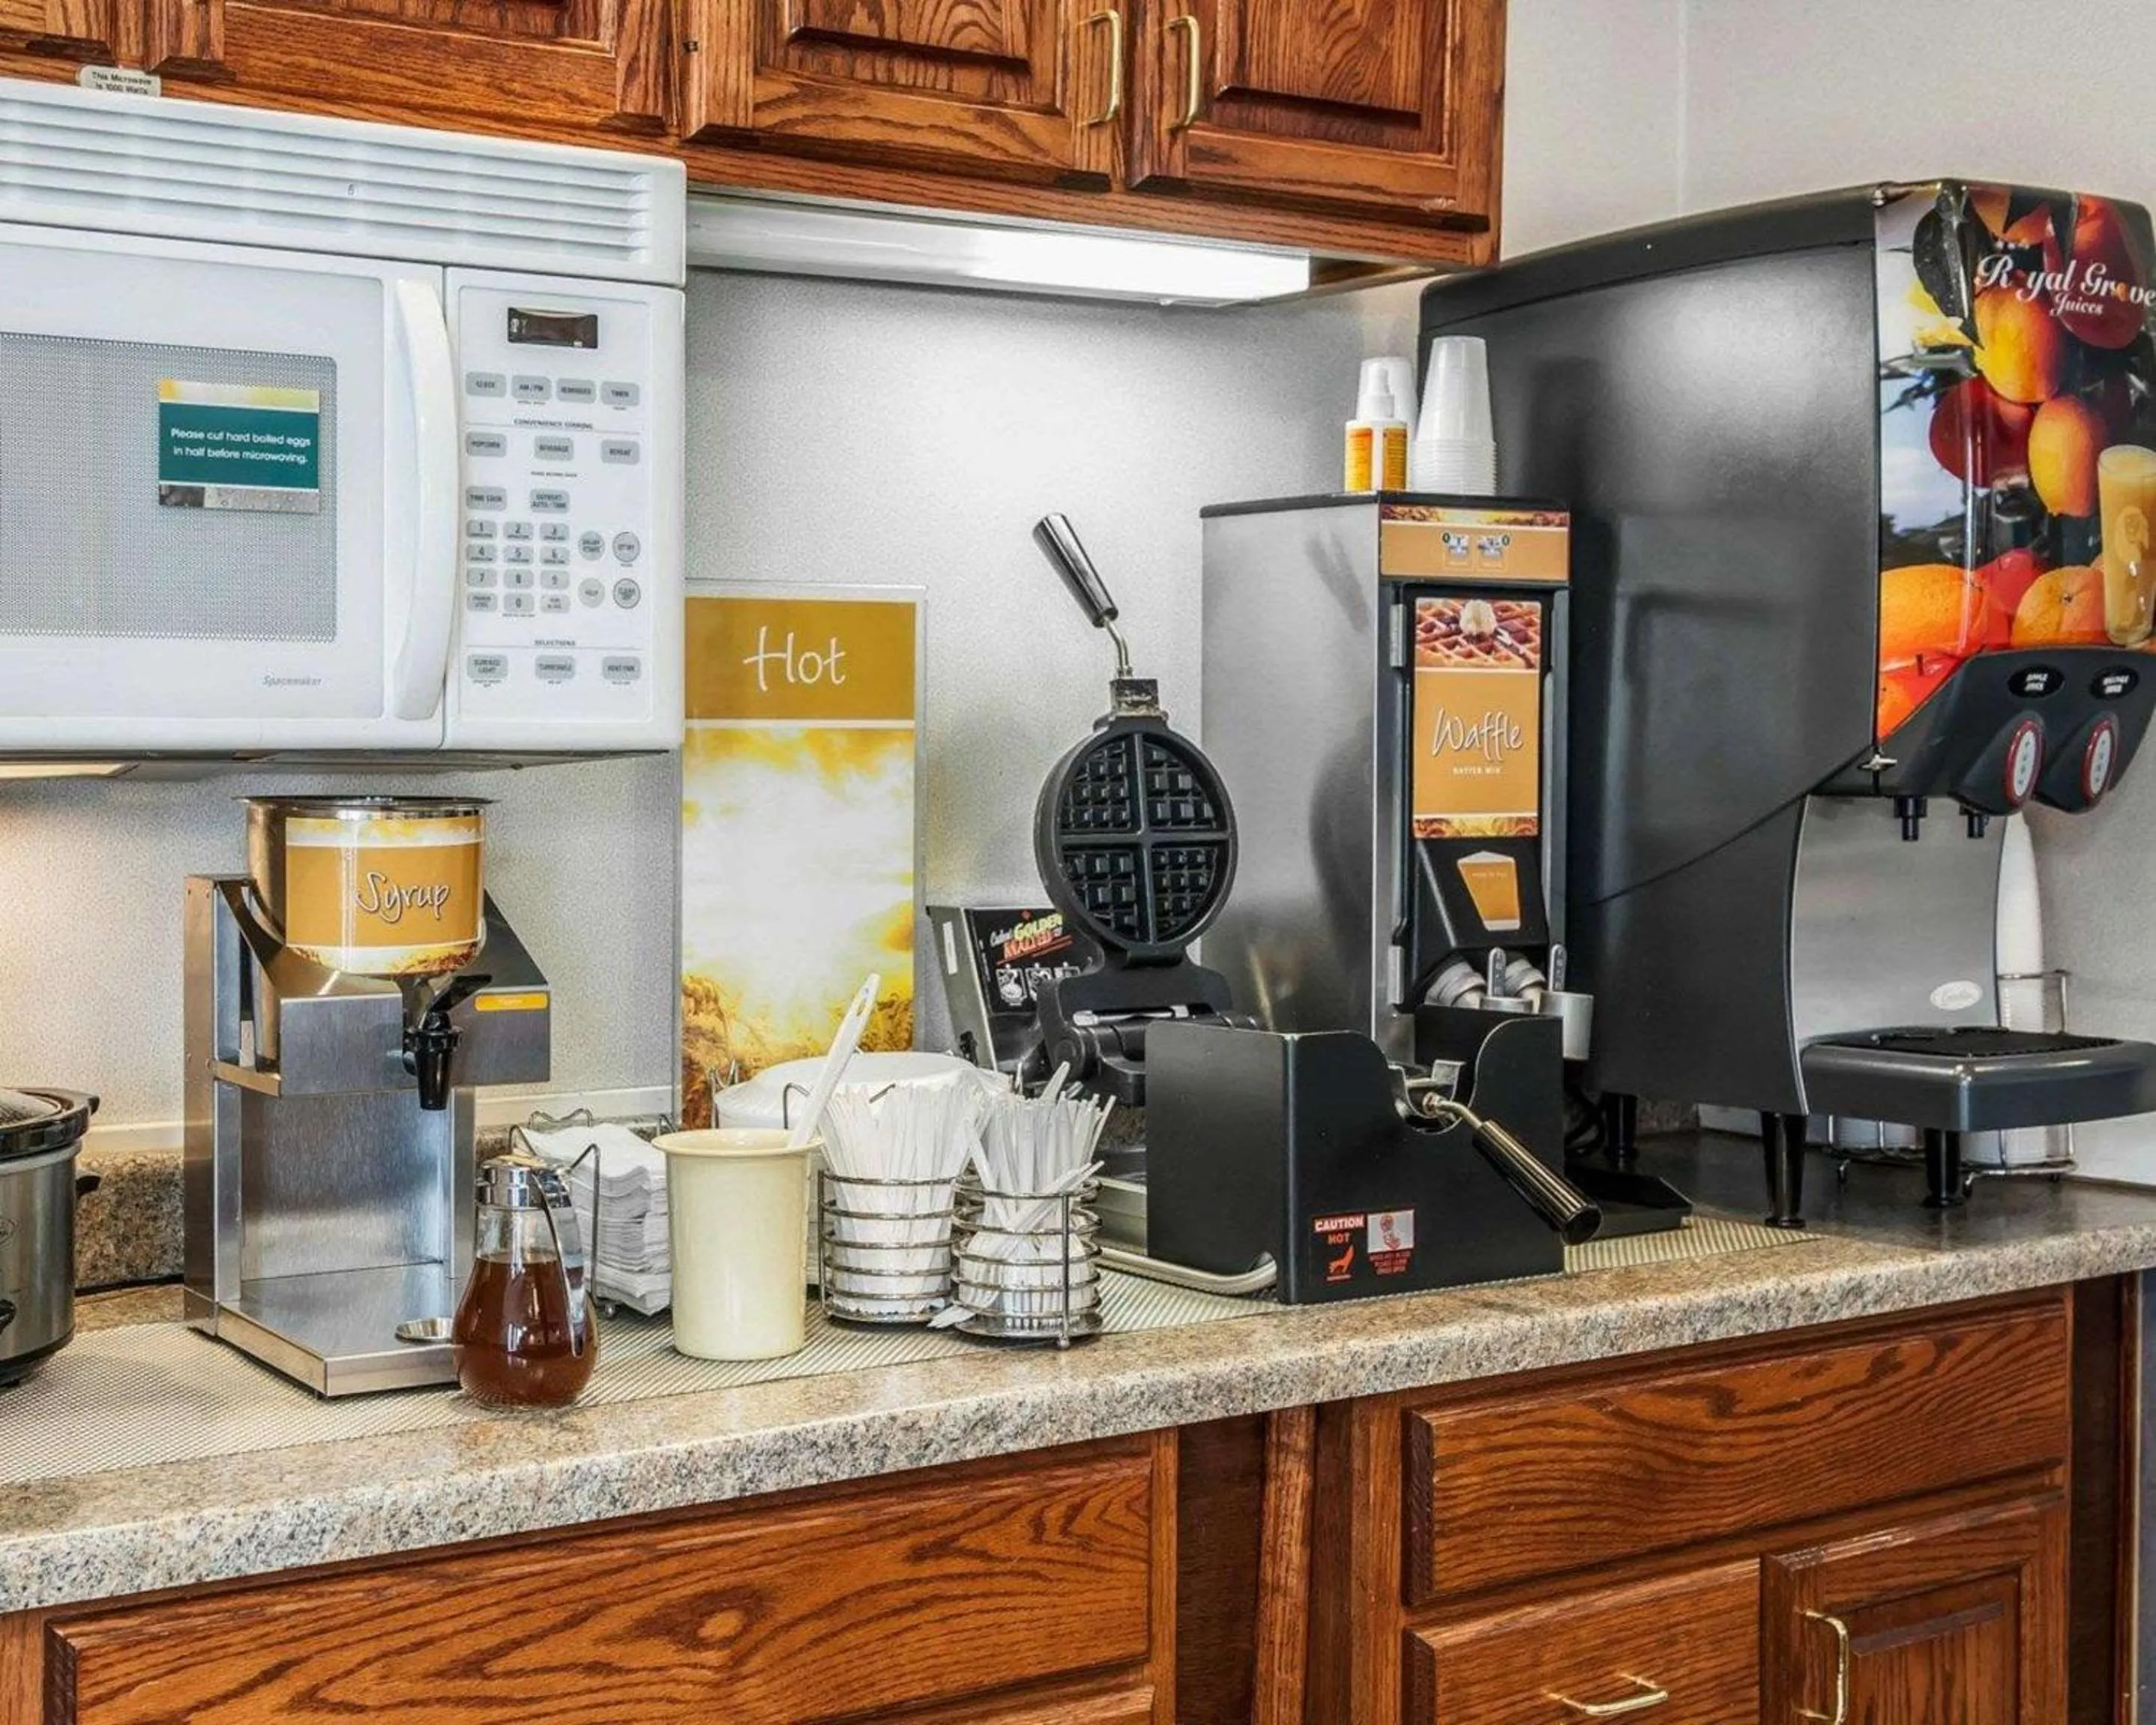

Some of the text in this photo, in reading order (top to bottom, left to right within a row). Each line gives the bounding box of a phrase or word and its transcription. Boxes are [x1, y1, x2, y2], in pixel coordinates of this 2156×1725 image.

[2049, 292, 2104, 317] Juices
[170, 428, 311, 448] Please cut hard boiled eggs
[185, 446, 205, 457] half
[207, 448, 240, 460] before
[242, 451, 308, 465] microwaving.
[743, 625, 847, 693] Hot
[1431, 706, 1524, 762] Waffle
[355, 871, 451, 924] Syrup
[1315, 1215, 1364, 1232] CAUTION
[1328, 1233, 1350, 1245] HOT
